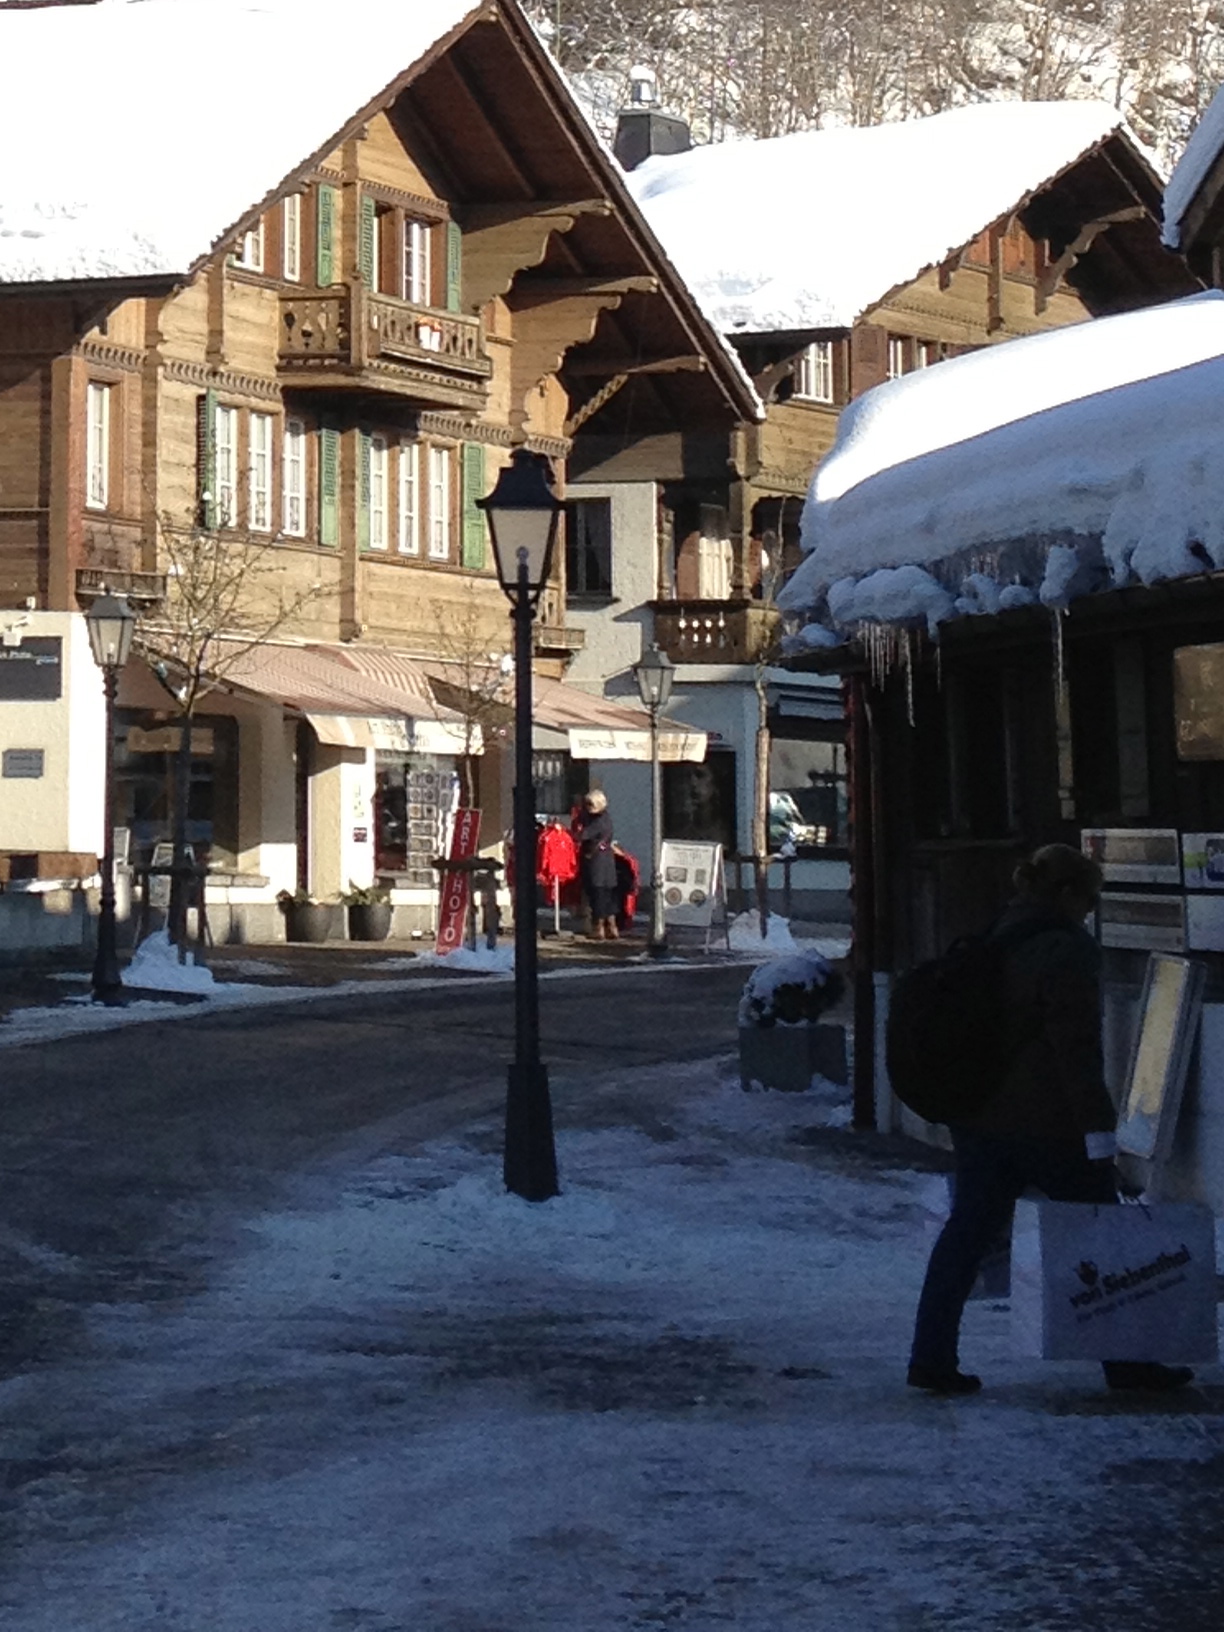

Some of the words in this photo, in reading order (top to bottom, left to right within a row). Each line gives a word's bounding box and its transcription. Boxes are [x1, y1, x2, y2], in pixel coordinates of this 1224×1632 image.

[444, 868, 464, 942] HOTO
[1069, 1286, 1103, 1308] von
[1102, 1242, 1192, 1296] Siebenthal
